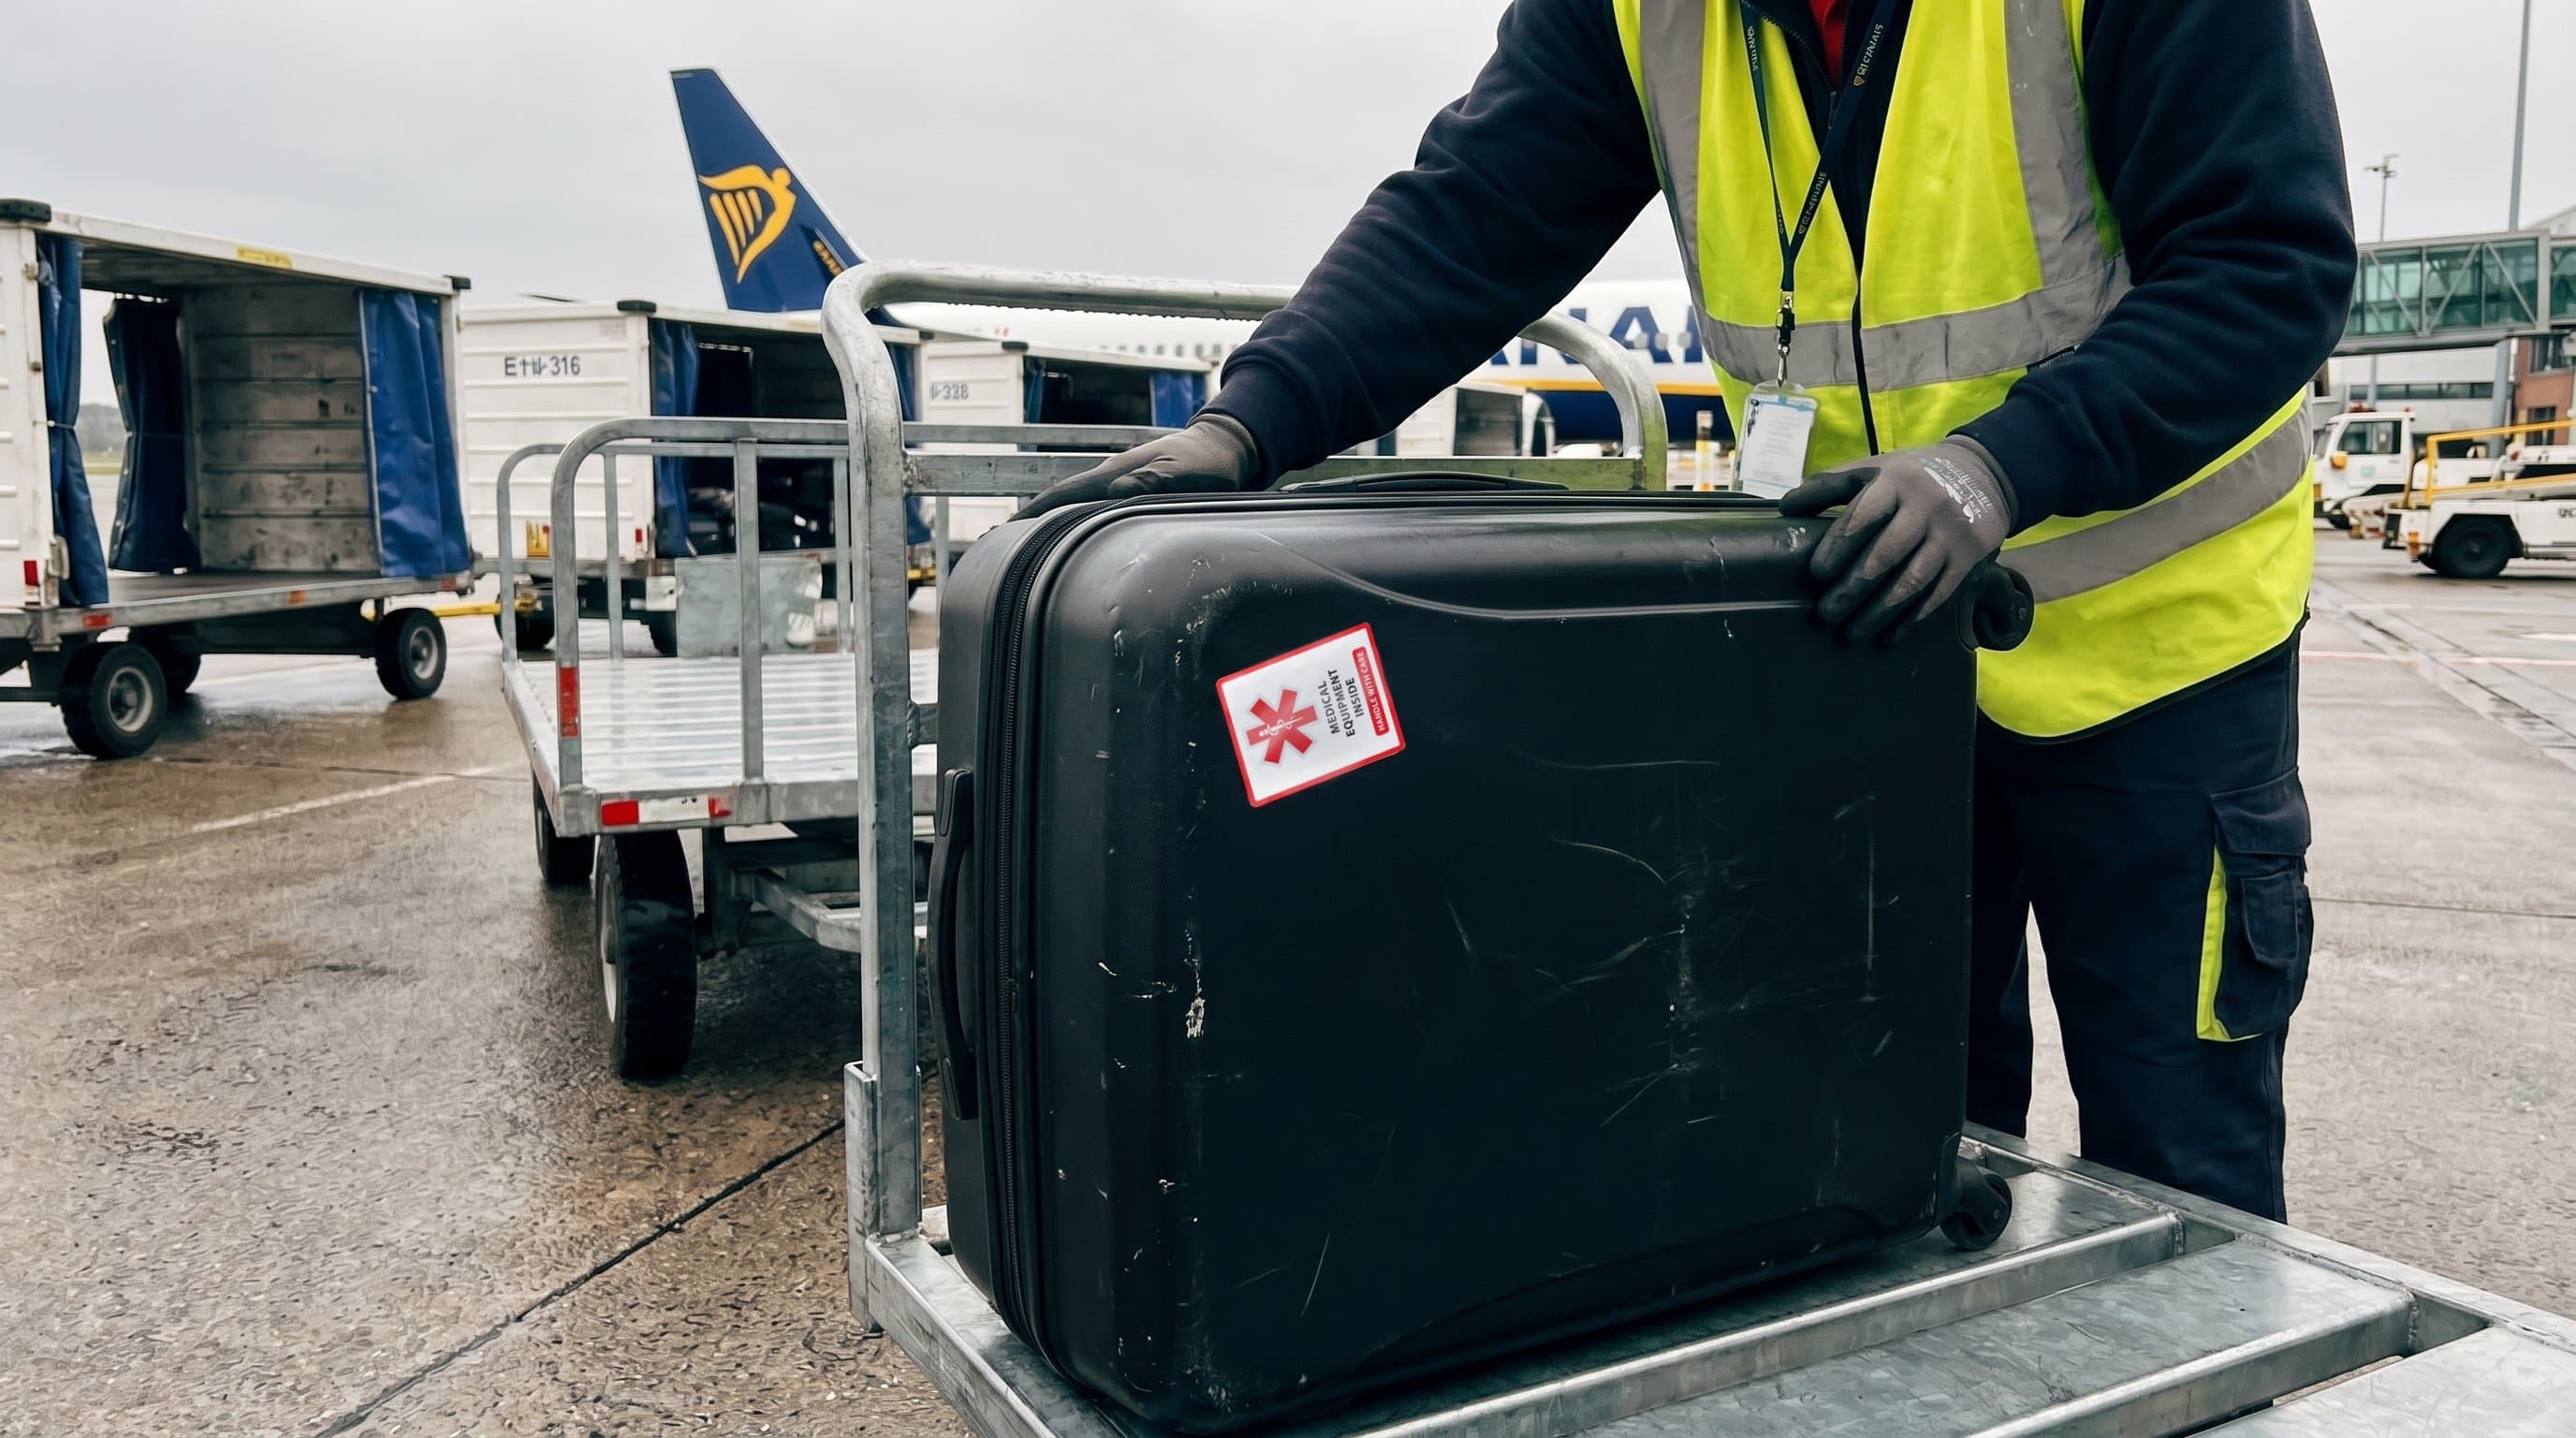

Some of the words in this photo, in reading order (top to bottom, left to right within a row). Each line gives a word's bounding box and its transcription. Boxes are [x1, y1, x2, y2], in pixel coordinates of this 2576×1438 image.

[1356, 651, 1368, 673] CARE
[1327, 669, 1355, 737] EQUIPMENT
[1345, 677, 1364, 717] INSIDE
[1364, 674, 1375, 697] WITH
[1318, 681, 1340, 734] MEDICAL
[1370, 697, 1385, 731] HANDLE
